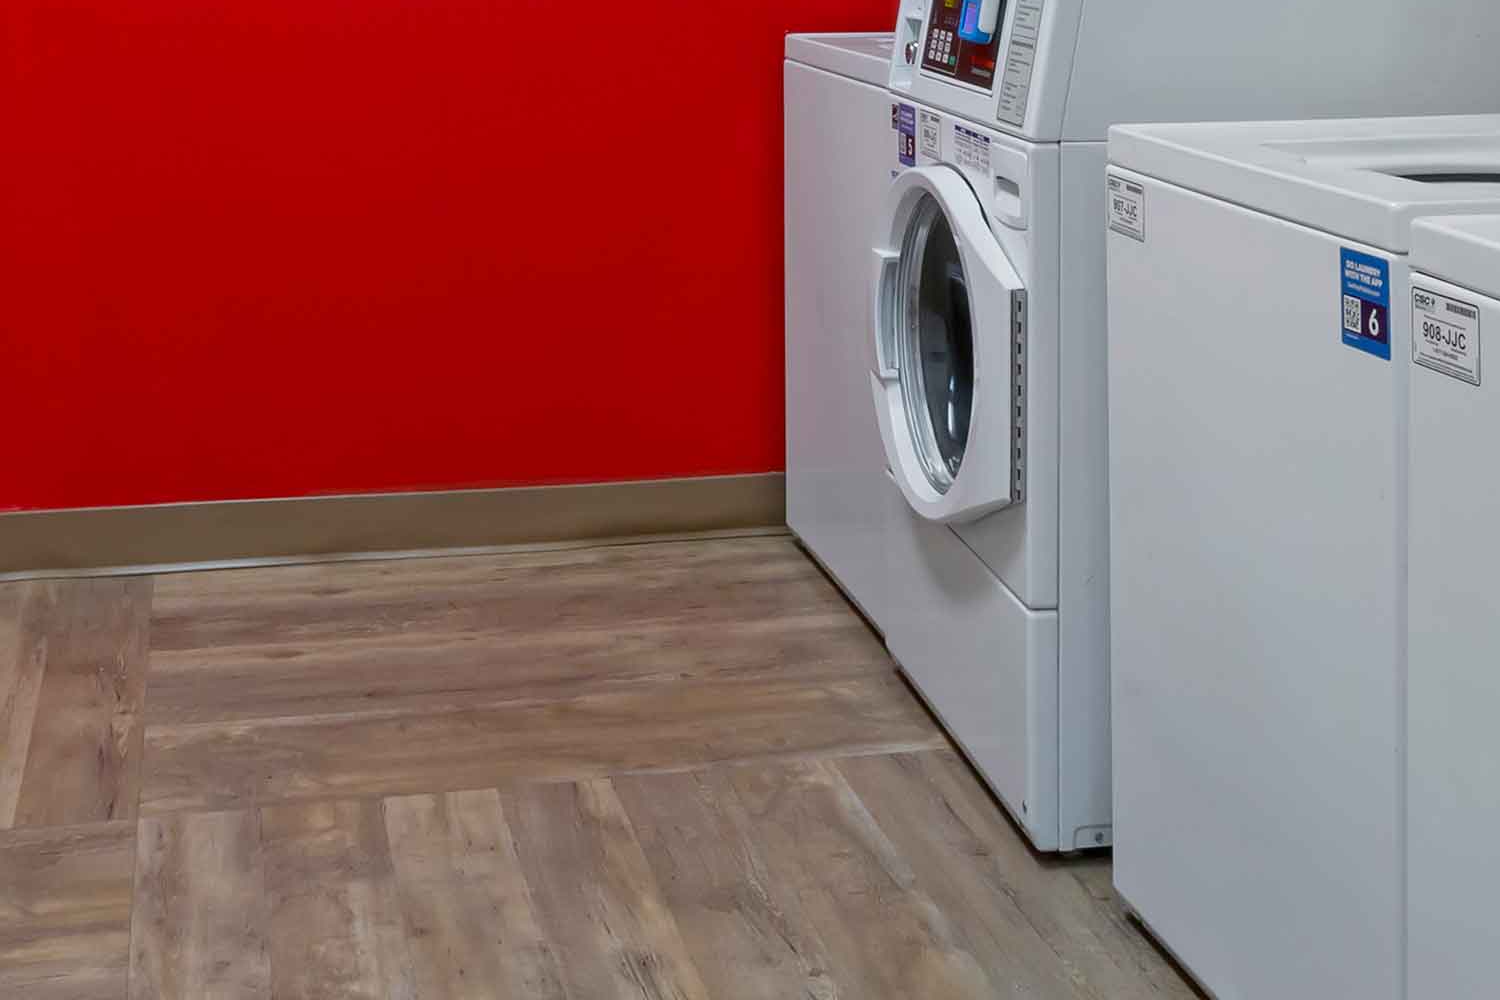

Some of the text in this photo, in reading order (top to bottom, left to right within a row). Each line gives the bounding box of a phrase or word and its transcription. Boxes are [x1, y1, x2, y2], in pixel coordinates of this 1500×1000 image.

[907, 138, 913, 156] 5
[1369, 308, 1379, 336] 6
[1423, 321, 1466, 350] 908-JJC
